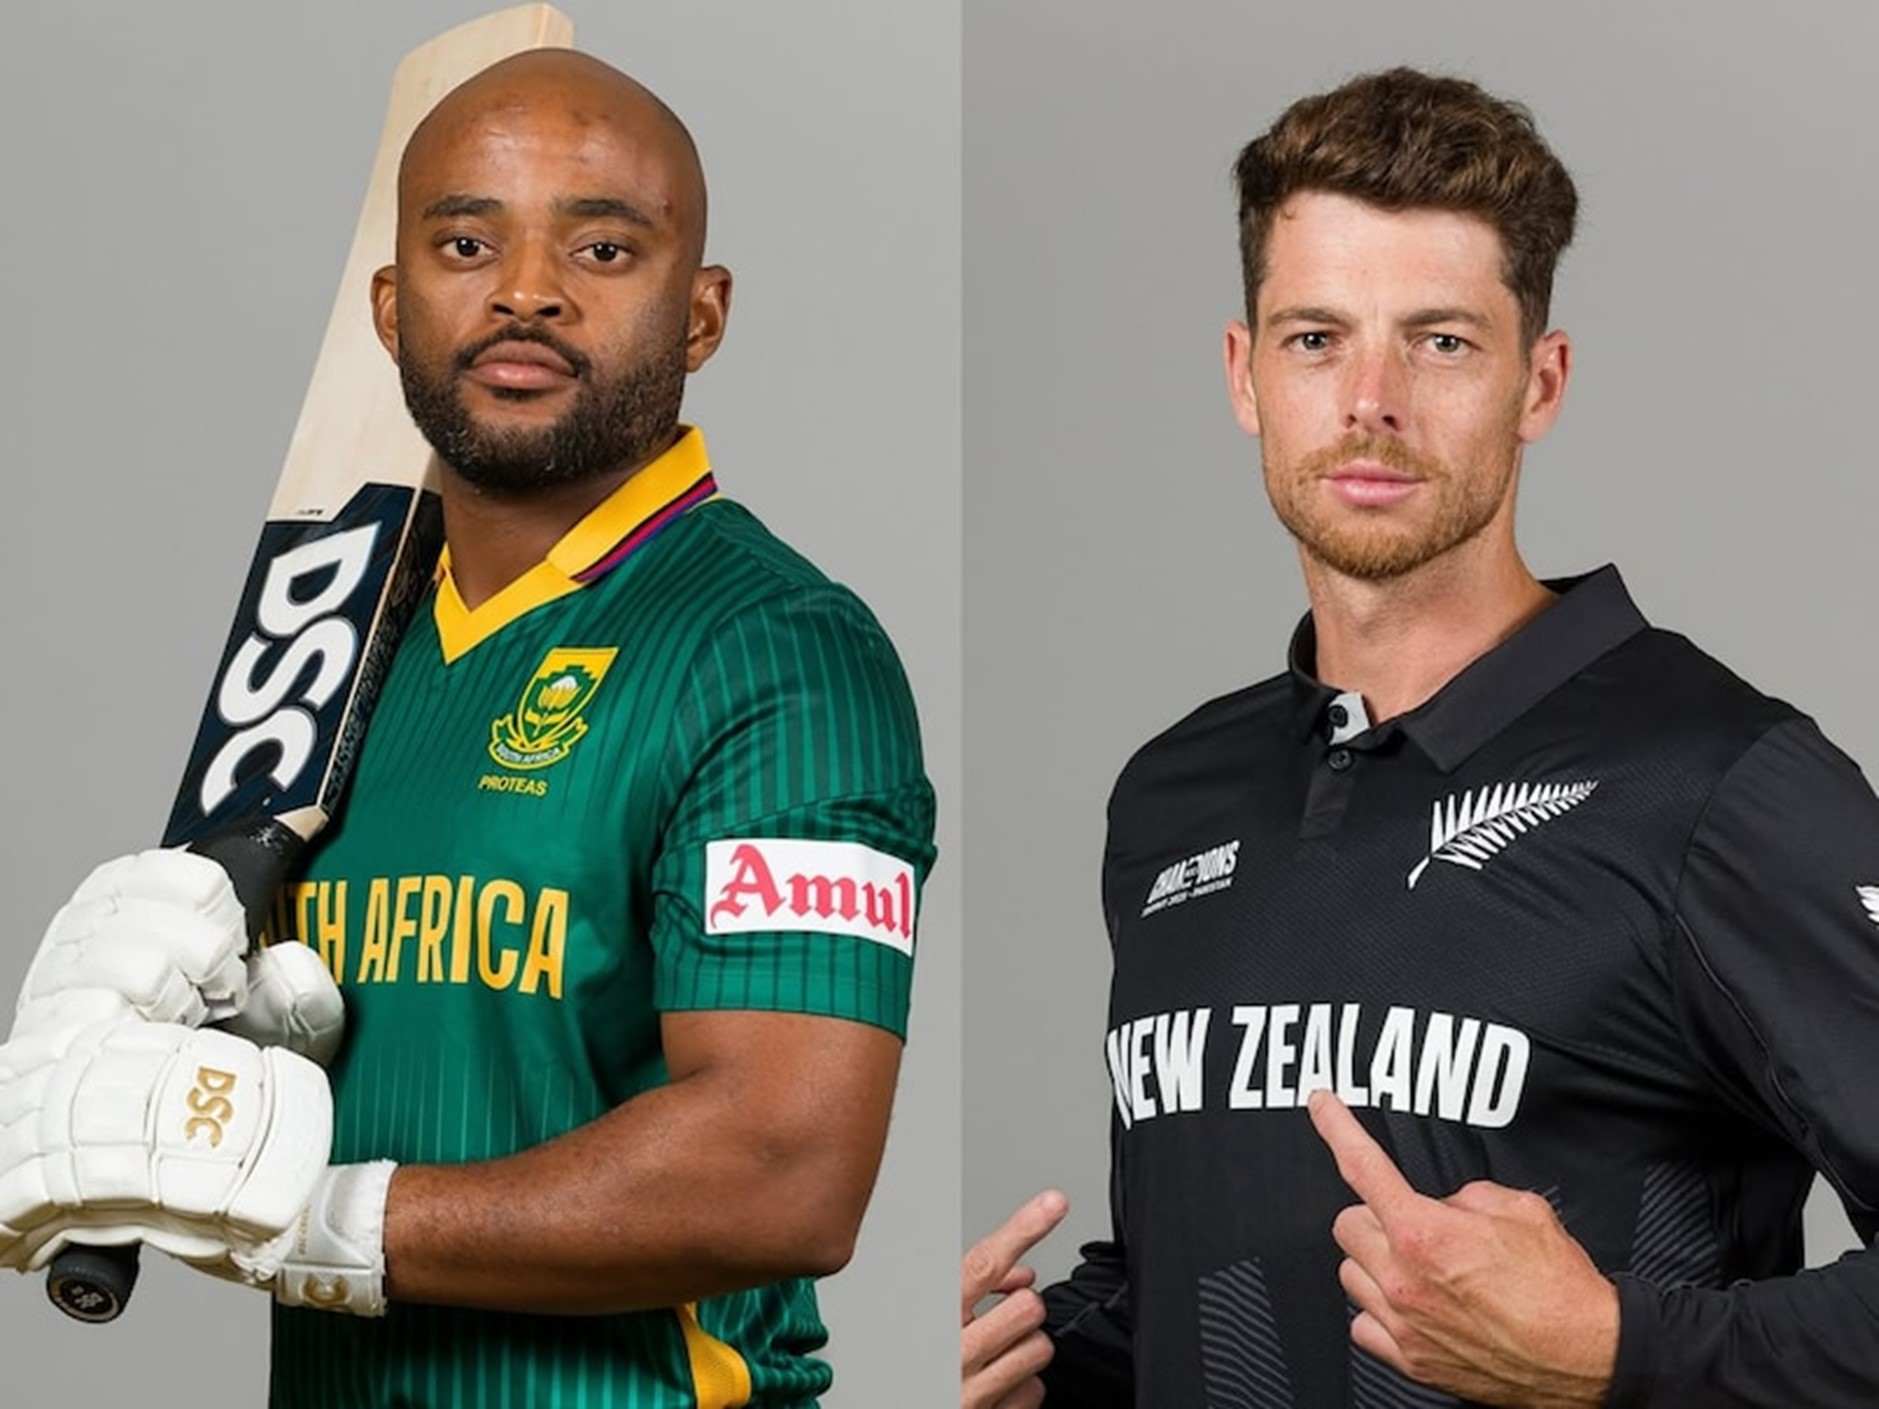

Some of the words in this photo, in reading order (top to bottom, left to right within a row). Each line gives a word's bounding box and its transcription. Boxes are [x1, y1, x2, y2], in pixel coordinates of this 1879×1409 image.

[201, 520, 381, 817] DSC
[478, 774, 548, 797] PROTEAS
[357, 875, 569, 998] AFRICA
[710, 844, 911, 939] Amul
[184, 1066, 236, 1149] DSC
[1106, 1007, 1212, 1130] NEW
[1229, 1003, 1530, 1128] ZEALAND
